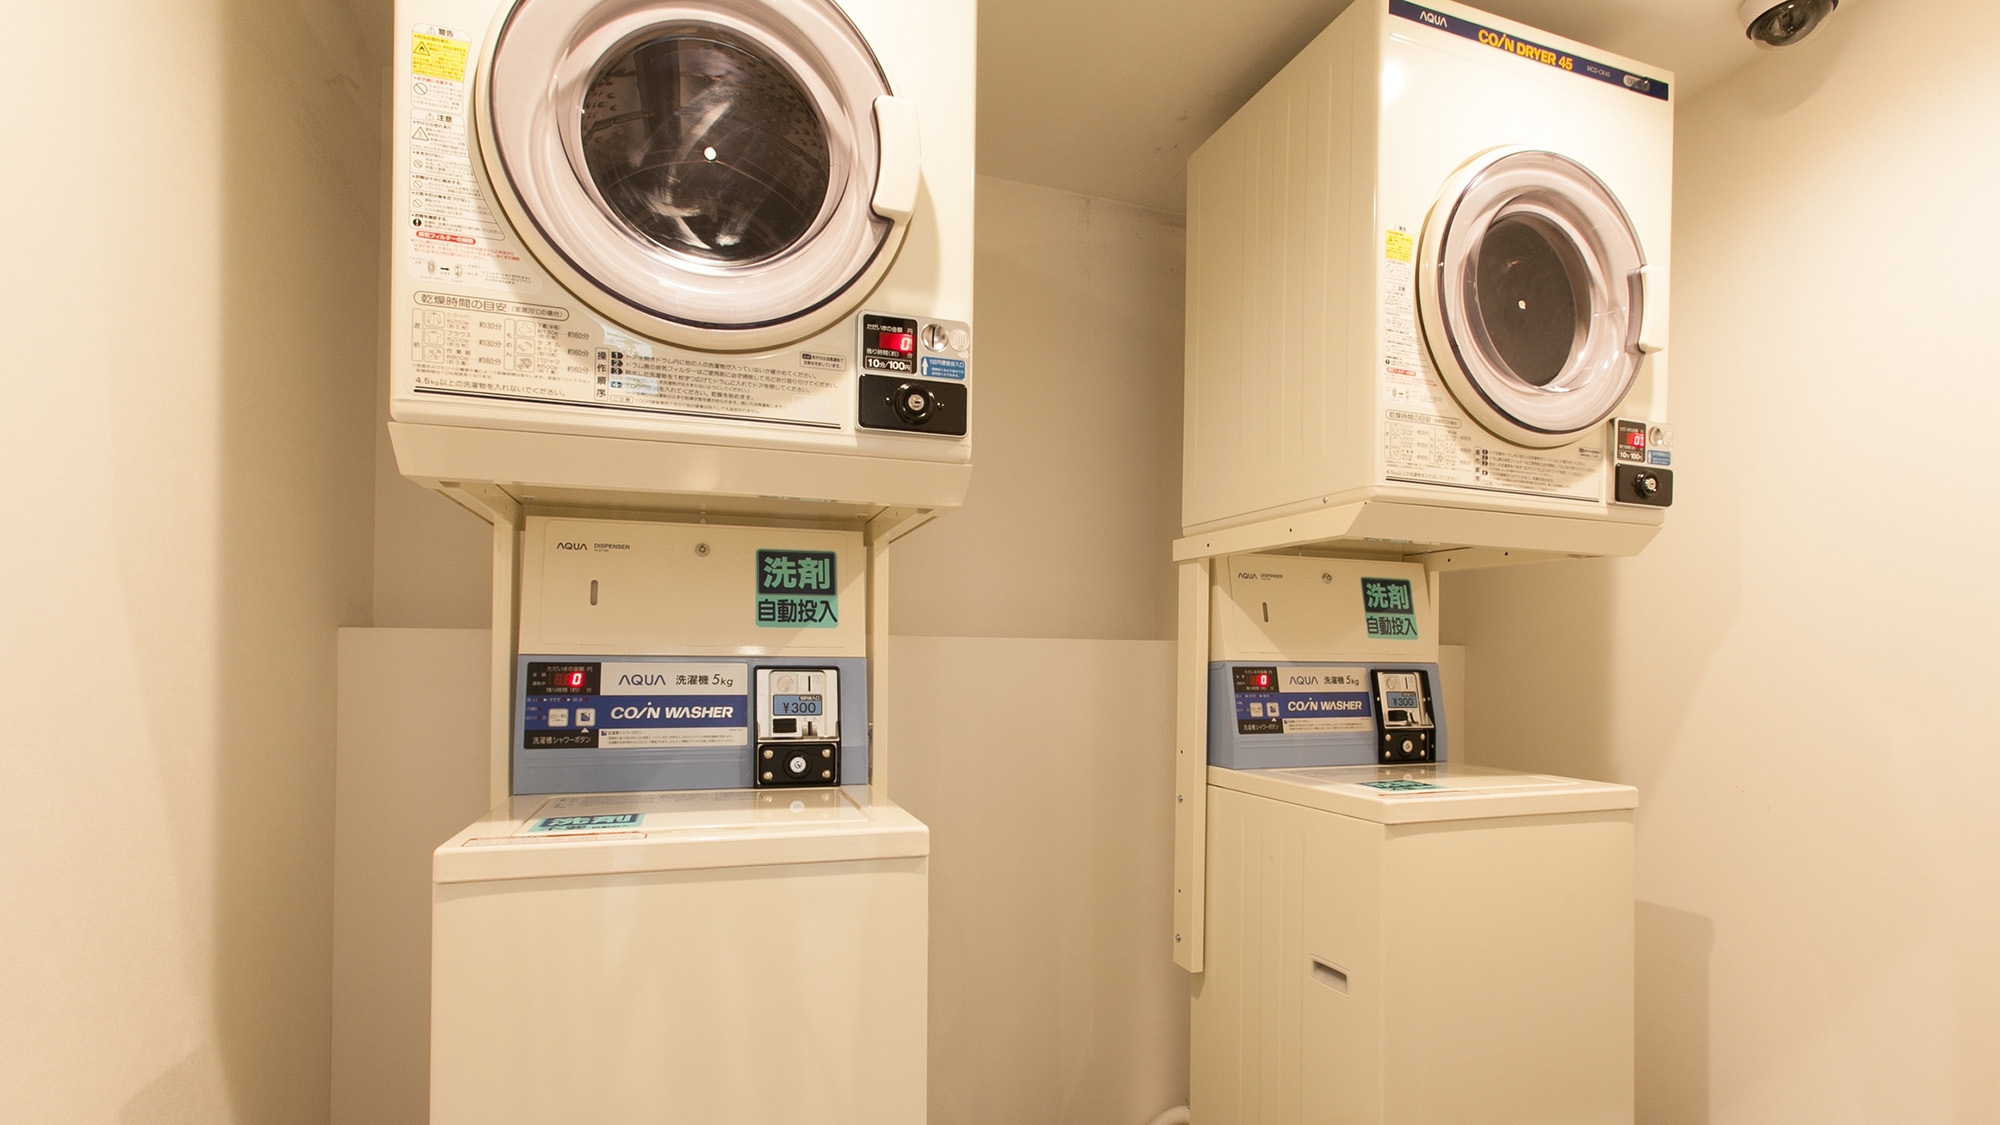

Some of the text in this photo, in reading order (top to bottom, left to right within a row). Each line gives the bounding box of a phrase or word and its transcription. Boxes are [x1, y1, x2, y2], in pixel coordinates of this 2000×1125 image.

[1419, 11, 1448, 28] AQUA
[1516, 42, 1557, 66] DRYER
[1558, 56, 1573, 71] 45
[437, 114, 453, 123] 注意
[421, 294, 507, 312] 乾燥時間の目安
[900, 337, 910, 351] 0
[596, 351, 607, 398] 操作順序
[556, 542, 588, 551] AQUA
[763, 556, 831, 590] 洗剤
[1238, 572, 1258, 580] AQUA
[1366, 582, 1410, 610] 洗剤
[758, 599, 838, 623] 自動投入
[1366, 616, 1418, 636] 自動投入
[572, 673, 582, 685] 0
[618, 673, 734, 687] AQUA 洗濯機 5kg
[1260, 674, 1267, 686] 0
[1289, 674, 1360, 687] AQUA 洗濯機 5kg
[783, 702, 817, 714] ¥300
[1321, 701, 1362, 711] WASHER
[1392, 697, 1414, 707] ¥300
[665, 706, 734, 719] WASHER
